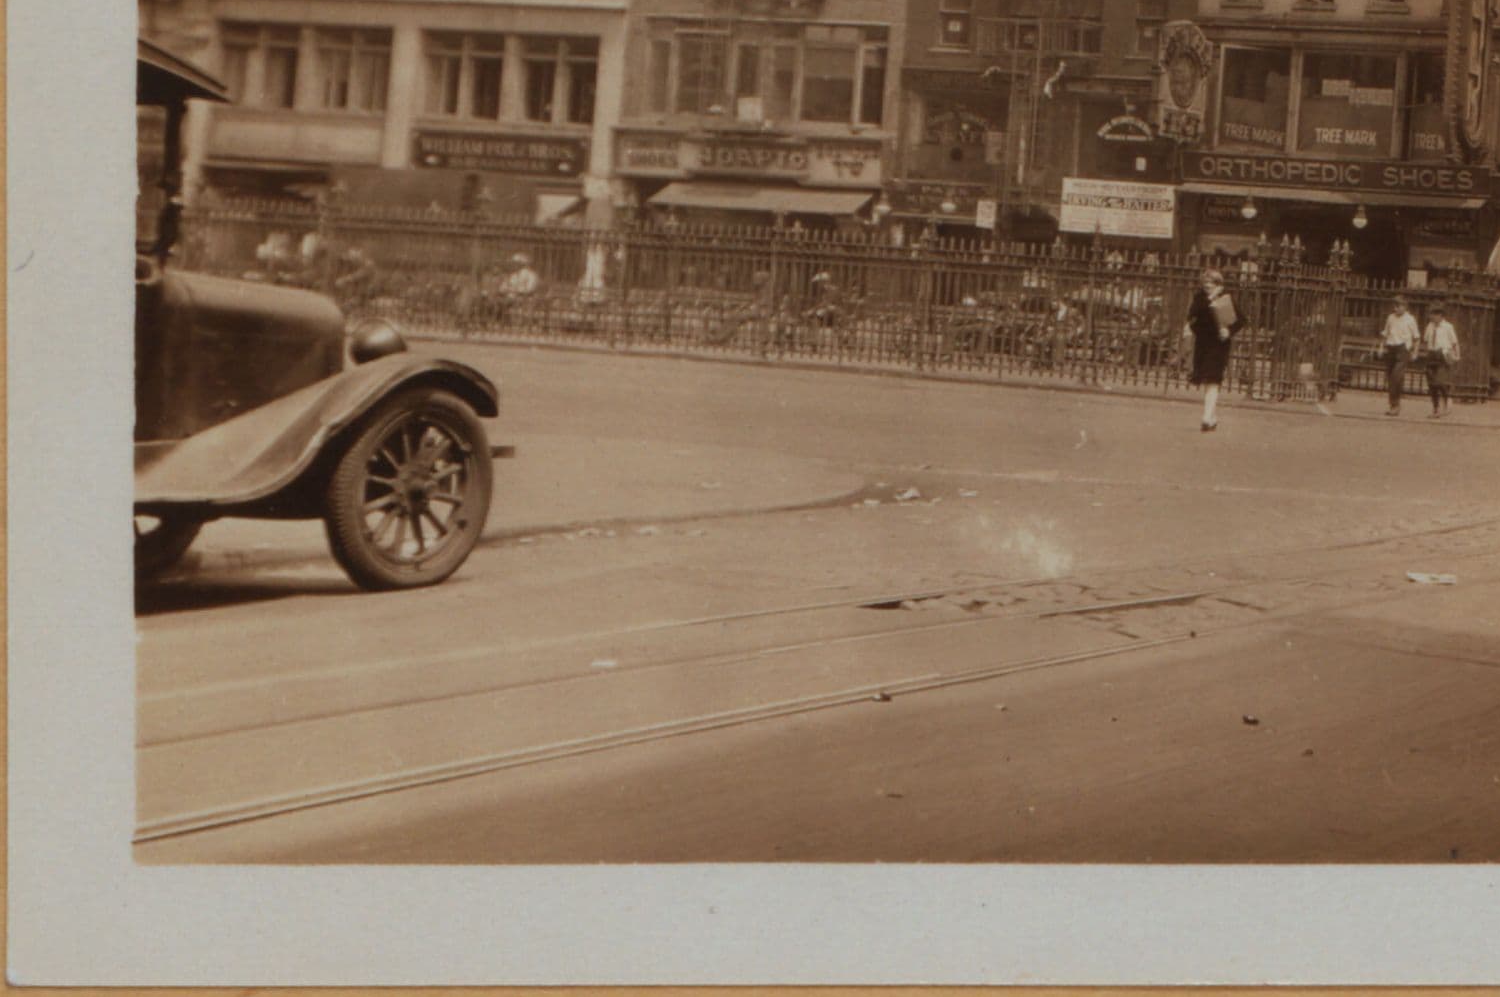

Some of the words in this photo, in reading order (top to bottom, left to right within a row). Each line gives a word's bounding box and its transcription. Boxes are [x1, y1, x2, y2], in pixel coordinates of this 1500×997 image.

[1224, 122, 1250, 140] TREE
[1250, 126, 1286, 147] MARK
[1314, 126, 1342, 145] TREE
[1342, 128, 1377, 147] MARK
[1199, 155, 1361, 185] ORTHOPEDIC
[1382, 165, 1474, 190] SHOES
